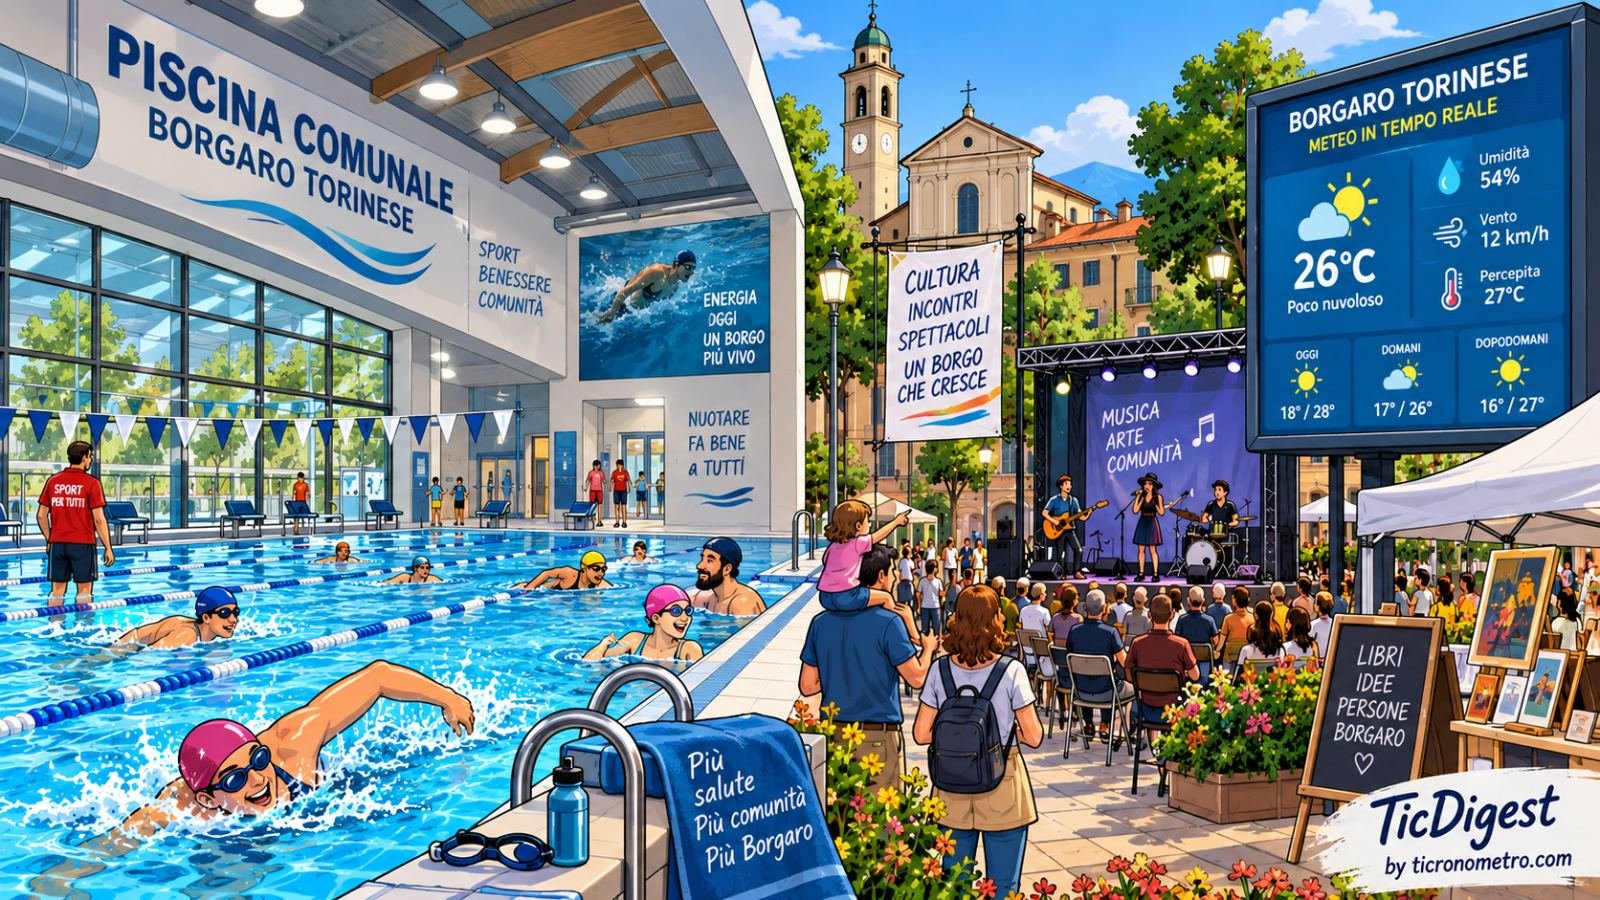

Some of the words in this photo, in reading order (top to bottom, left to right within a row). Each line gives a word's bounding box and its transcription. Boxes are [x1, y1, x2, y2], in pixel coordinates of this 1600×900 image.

[1289, 87, 1394, 133] BORGARO
[1402, 53, 1528, 105] TORINESE
[108, 25, 283, 143] PISCINA
[294, 112, 454, 214] COMUNALE
[1309, 129, 1357, 153] METEO
[1361, 125, 1376, 142] IN
[1381, 111, 1437, 138] TEMPO
[1443, 97, 1498, 125] REALE
[1480, 147, 1529, 166] Umidità
[149, 106, 295, 188] BORGARO
[304, 166, 414, 234] TORINESE
[1480, 168, 1520, 188] 54%
[1480, 212, 1517, 226] Vento
[1481, 231, 1500, 248] 12
[1506, 225, 1549, 246] km/h
[479, 241, 520, 264] SPORT
[479, 265, 551, 293] BENESSERE
[905, 259, 980, 295] CULTURA
[1294, 249, 1375, 289] 26°C
[1480, 266, 1540, 285] Percepita
[479, 291, 543, 316] COMUNITÀ
[704, 290, 757, 307] ENERGIA
[908, 290, 977, 322] INCONTRI
[1288, 299, 1319, 314] Poco
[1323, 292, 1383, 311] nuvoloso
[1484, 286, 1525, 305] 27°C
[709, 311, 736, 326] OGGI
[704, 332, 719, 346] UN
[725, 330, 765, 345] BORGO
[899, 316, 989, 351] SPETTACOLI
[1476, 333, 1548, 348] DOPODOMANI
[704, 347, 722, 365] PIÙ
[727, 350, 755, 364] VIVO
[1296, 350, 1319, 360] OGGI
[1382, 343, 1421, 355] DOMANI
[905, 359, 925, 378] UN
[932, 348, 982, 373] BORGO
[898, 381, 926, 404] CHE
[931, 369, 988, 397] CRESCE
[1102, 401, 1160, 429] MUSICA
[1280, 405, 1301, 419] 18°
[1313, 404, 1335, 418] 28°
[1374, 402, 1395, 416] 17°
[1410, 401, 1432, 415] 26°
[1480, 399, 1505, 413] 16°
[1520, 397, 1544, 411] 27°
[689, 409, 750, 427] NUOTARE
[689, 436, 704, 451] FA
[711, 435, 745, 451] BENE
[1106, 429, 1143, 451] ARTE
[54, 484, 83, 495] SPORT
[65, 497, 85, 508] TUTTI
[1357, 645, 1403, 667] LIBRI
[1356, 673, 1395, 693] IDEE
[1337, 698, 1410, 721] PERSONE
[1334, 723, 1405, 747] BORGARO
[688, 749, 724, 779] Più
[695, 771, 755, 806] salute
[695, 811, 724, 840] Più
[731, 786, 806, 827] comunità
[706, 845, 735, 873] Più
[742, 824, 813, 860] Borgaro
